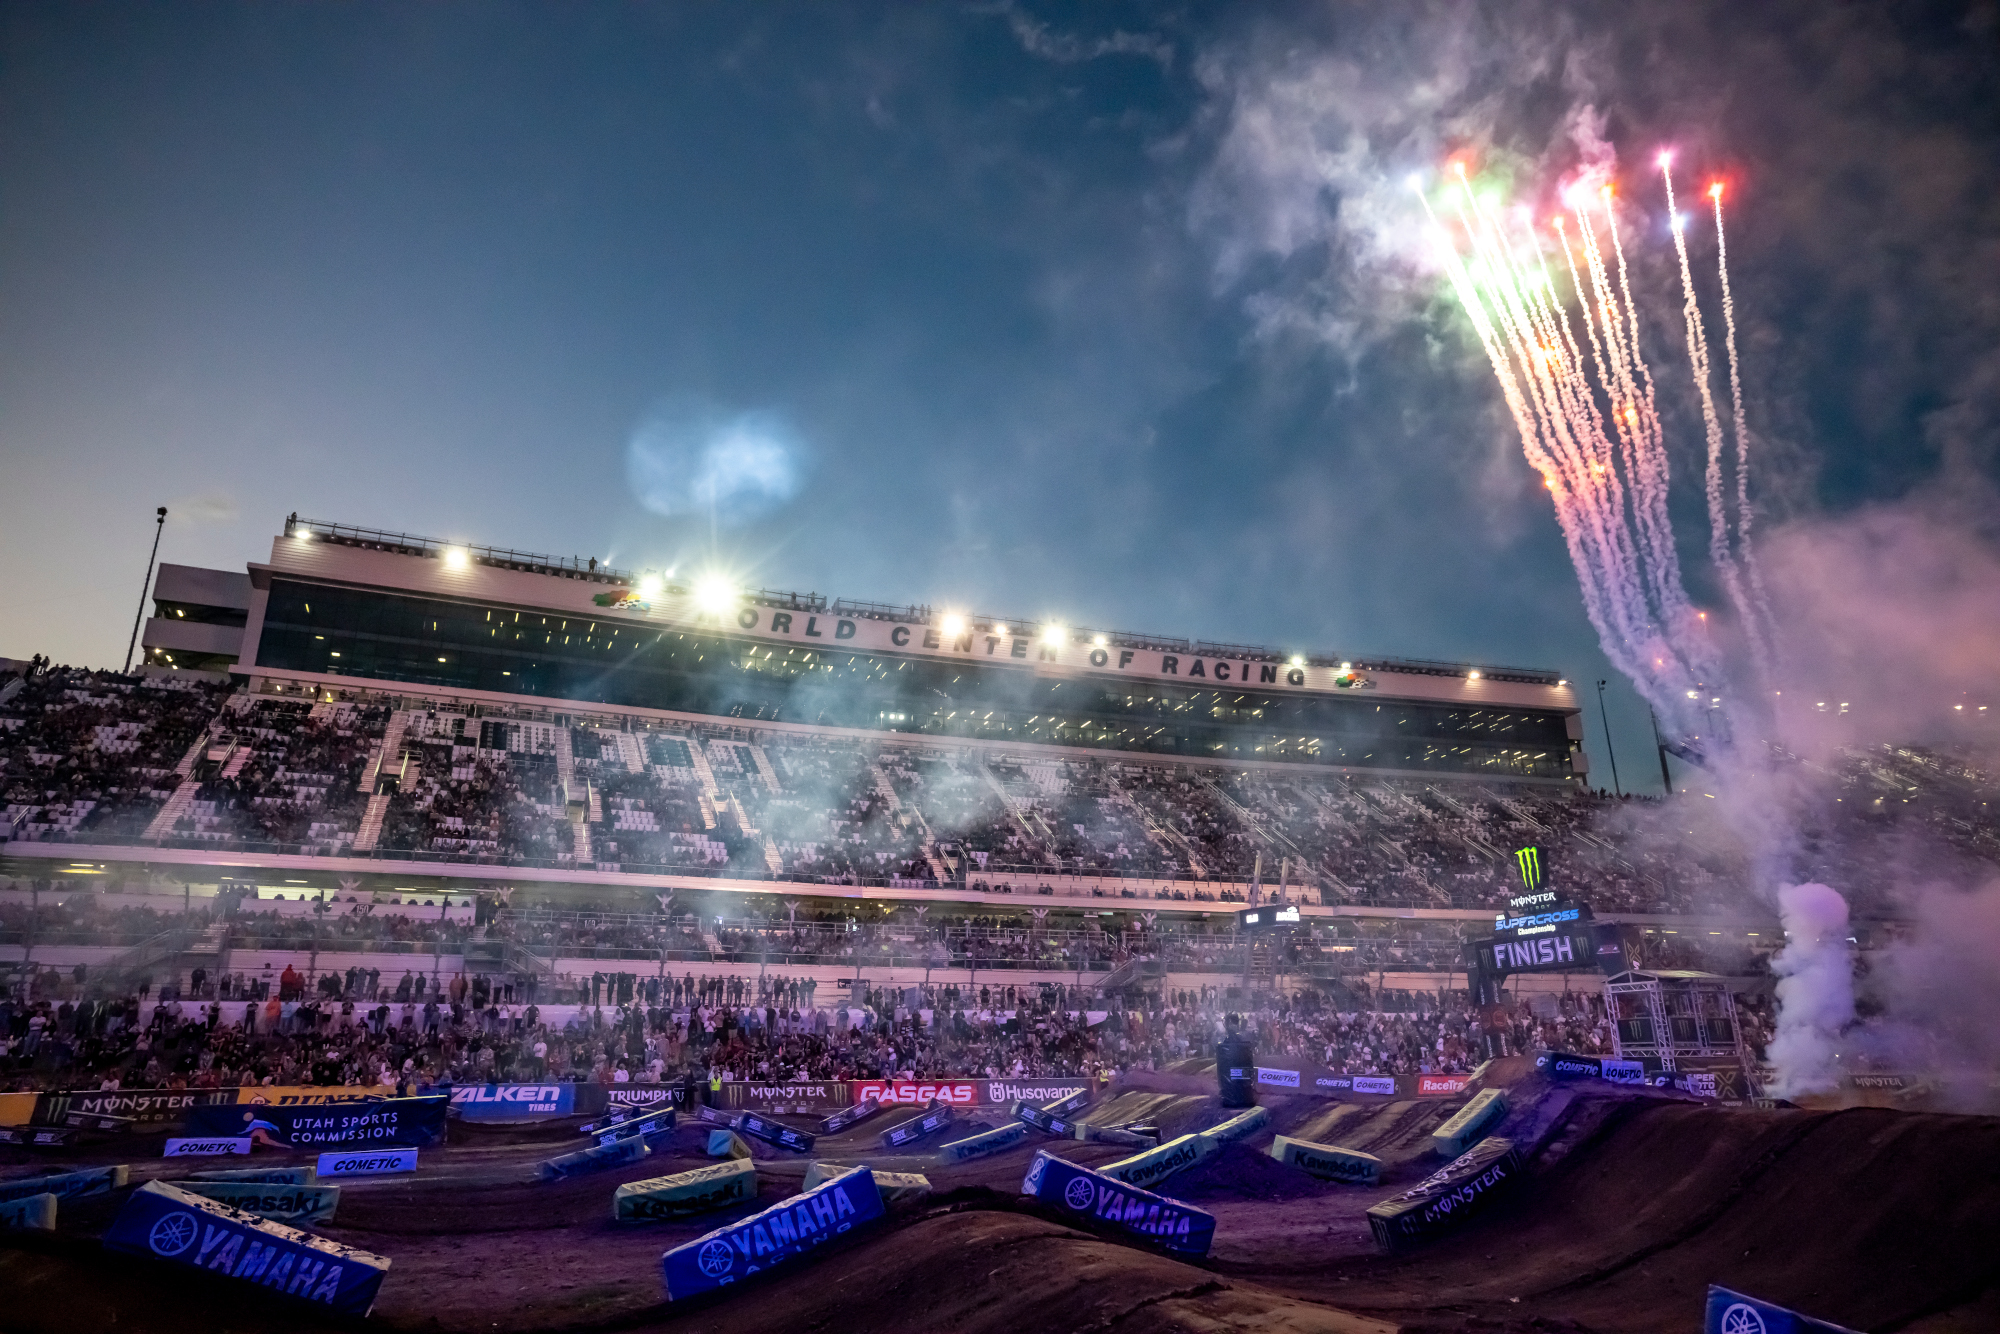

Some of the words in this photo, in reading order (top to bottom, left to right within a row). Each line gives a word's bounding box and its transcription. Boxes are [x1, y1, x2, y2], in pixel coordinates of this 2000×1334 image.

[1089, 647, 1135, 670] OF
[1160, 654, 1306, 687] RACING
[1510, 891, 1557, 907] MONSTER
[1495, 908, 1580, 931] SUPERCROSS
[1517, 924, 1557, 935] Championship
[1493, 935, 1575, 968] FINISH
[1260, 1072, 1298, 1083] COMETIC
[1315, 1077, 1351, 1088] COMETIC
[1356, 1080, 1392, 1091] COMETIC
[608, 1090, 672, 1102] TRIUMPH
[750, 1086, 827, 1100] MONSTER
[860, 1085, 972, 1103] GASGAS
[82, 1095, 196, 1113] MONSTER
[528, 1103, 557, 1112] TIRES
[292, 1117, 335, 1129] UTAH
[341, 1111, 399, 1129] SPORTS
[290, 1127, 397, 1143] COMMISSION
[955, 1128, 1020, 1160] Kawasaki
[178, 1142, 238, 1153] COMETIC
[333, 1156, 402, 1172] COMETIC
[1118, 1143, 1198, 1185] Kawasaki
[1293, 1150, 1373, 1178] Kawasaki
[1424, 1163, 1507, 1223] MONSTER
[731, 1185, 856, 1262] YAMAHA
[1095, 1185, 1190, 1244] YAMAHA
[193, 1223, 344, 1305] YAMAHA
